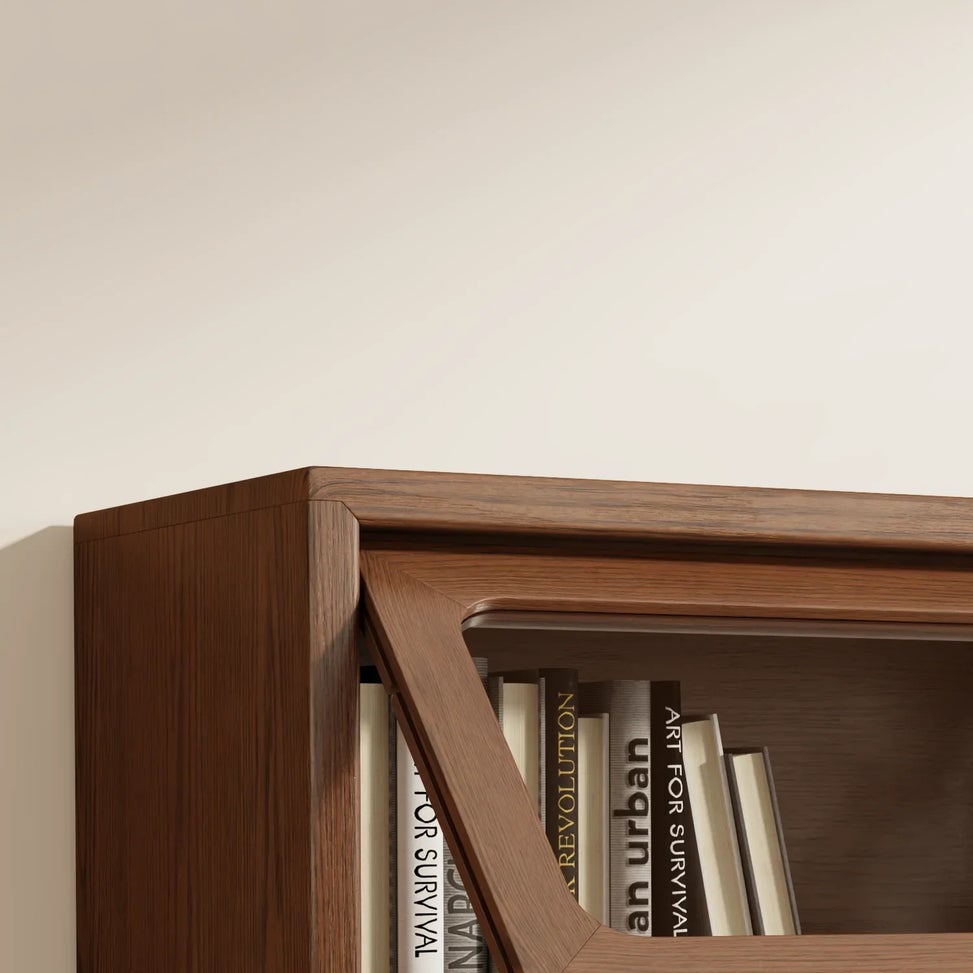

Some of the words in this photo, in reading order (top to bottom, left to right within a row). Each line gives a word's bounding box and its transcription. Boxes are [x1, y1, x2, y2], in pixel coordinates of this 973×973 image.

[557, 692, 576, 869] REVOLUTION
[665, 706, 683, 754] ART
[612, 737, 650, 866] urban
[667, 764, 685, 815] FOR
[414, 848, 438, 957] SURVIVAL
[669, 823, 689, 938] SURVIVAL
